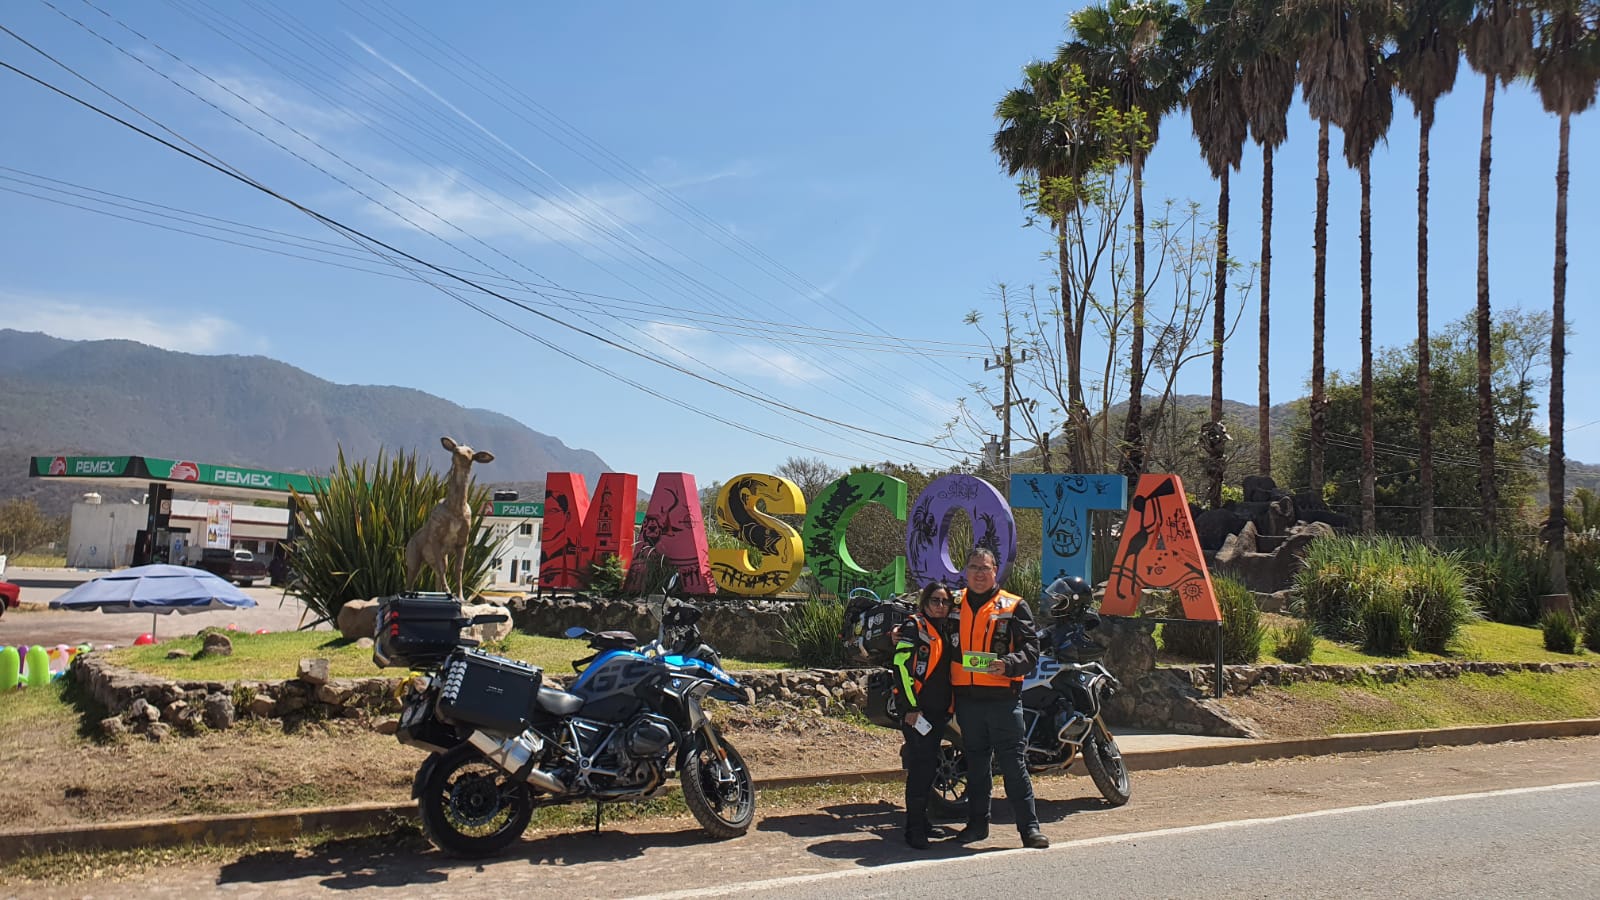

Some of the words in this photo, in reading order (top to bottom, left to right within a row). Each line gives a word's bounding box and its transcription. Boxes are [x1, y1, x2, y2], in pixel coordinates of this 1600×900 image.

[75, 460, 115, 473] PEMEX
[214, 469, 273, 487] PEMEX
[502, 505, 539, 515] PEMEX
[539, 471, 1223, 622] MASCOTA
